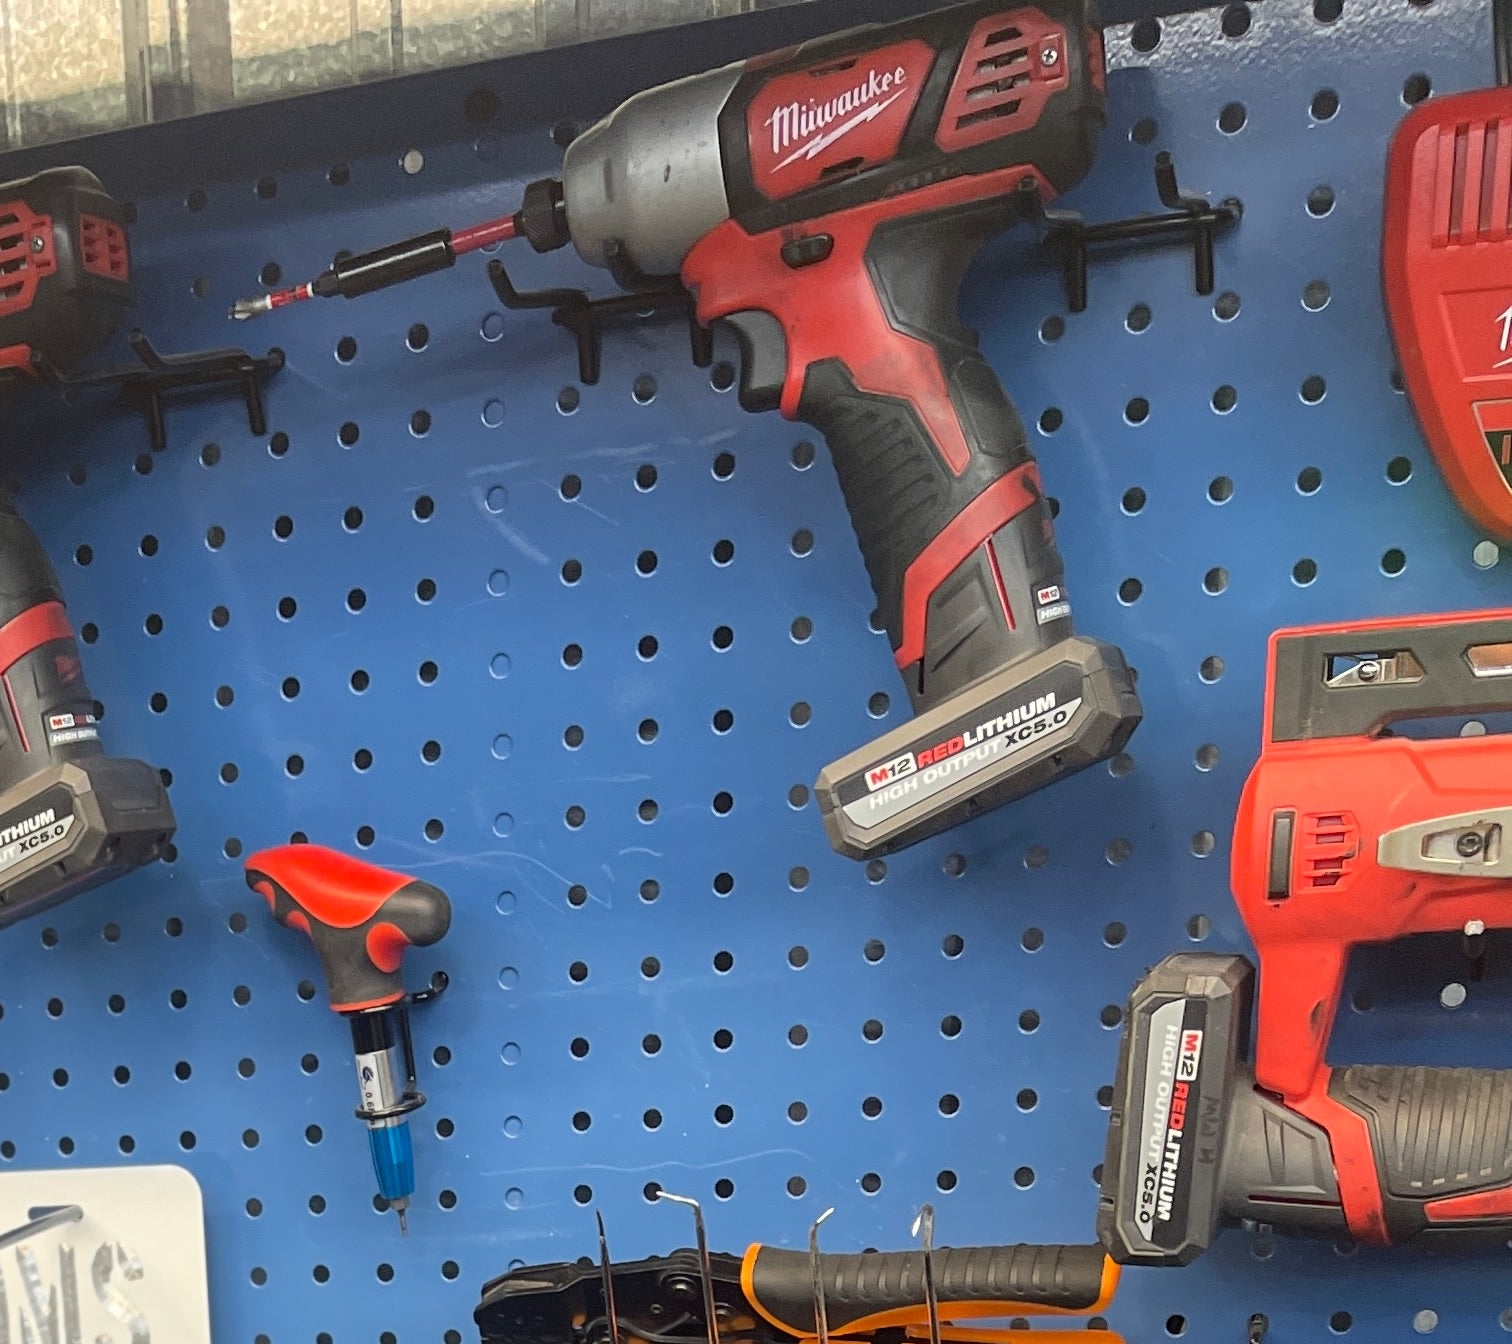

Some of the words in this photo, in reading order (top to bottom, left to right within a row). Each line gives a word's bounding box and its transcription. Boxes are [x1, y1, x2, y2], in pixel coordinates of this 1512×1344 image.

[764, 66, 907, 154] Milwaukee
[869, 779, 918, 810] HIGH
[923, 741, 1002, 784] OUTPUT
[1005, 709, 1067, 748] XC5.0
[869, 757, 912, 786] M12
[19, 823, 65, 853] XC5.0
[1160, 1024, 1178, 1078] HIGH
[1181, 1033, 1199, 1078] M12
[1148, 1082, 1171, 1162] OUTPUT
[1139, 1162, 1159, 1224] XC5.0
